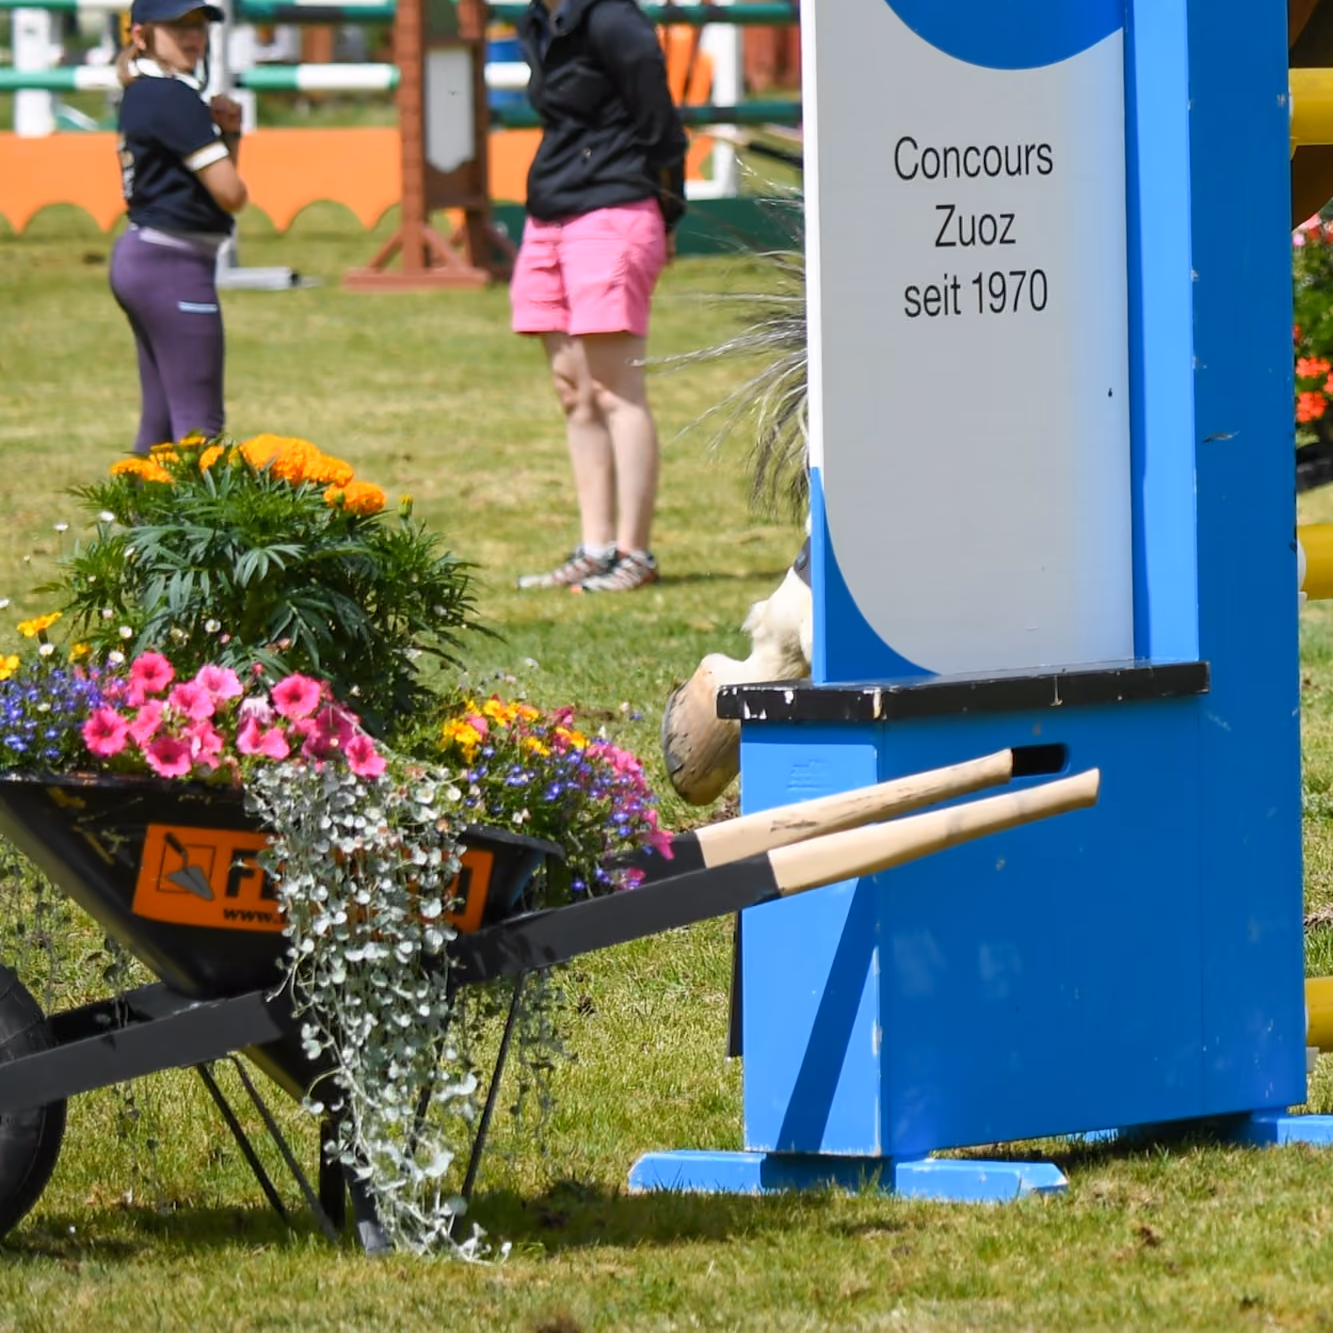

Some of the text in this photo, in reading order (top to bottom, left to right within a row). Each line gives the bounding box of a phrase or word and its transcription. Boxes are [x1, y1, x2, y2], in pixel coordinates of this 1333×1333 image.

[894, 135, 1054, 181] Concours
[934, 203, 1017, 248] Zuoz
[904, 268, 1048, 318] seit 1970
